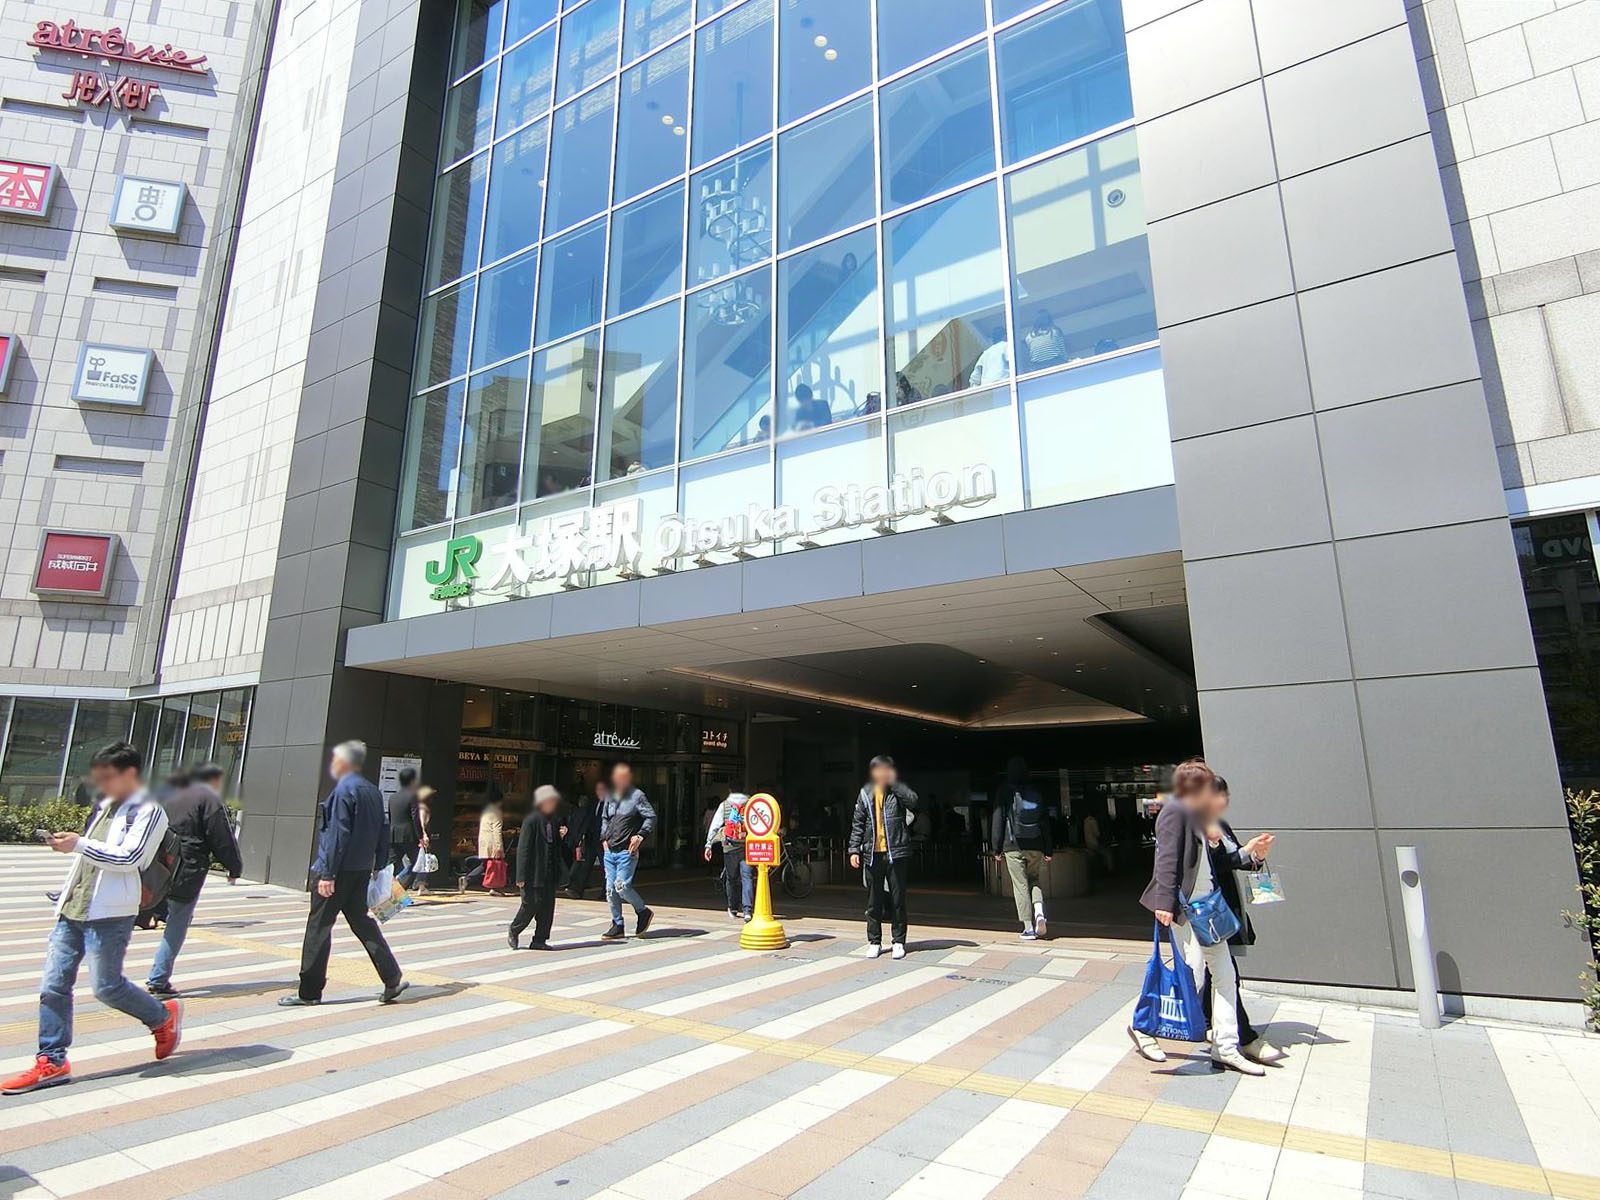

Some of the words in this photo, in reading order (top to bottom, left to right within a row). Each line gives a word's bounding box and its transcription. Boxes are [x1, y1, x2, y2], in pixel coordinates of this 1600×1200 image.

[425, 535, 482, 585] JR
[489, 498, 644, 590] 大塚駅
[813, 462, 996, 528] Station
